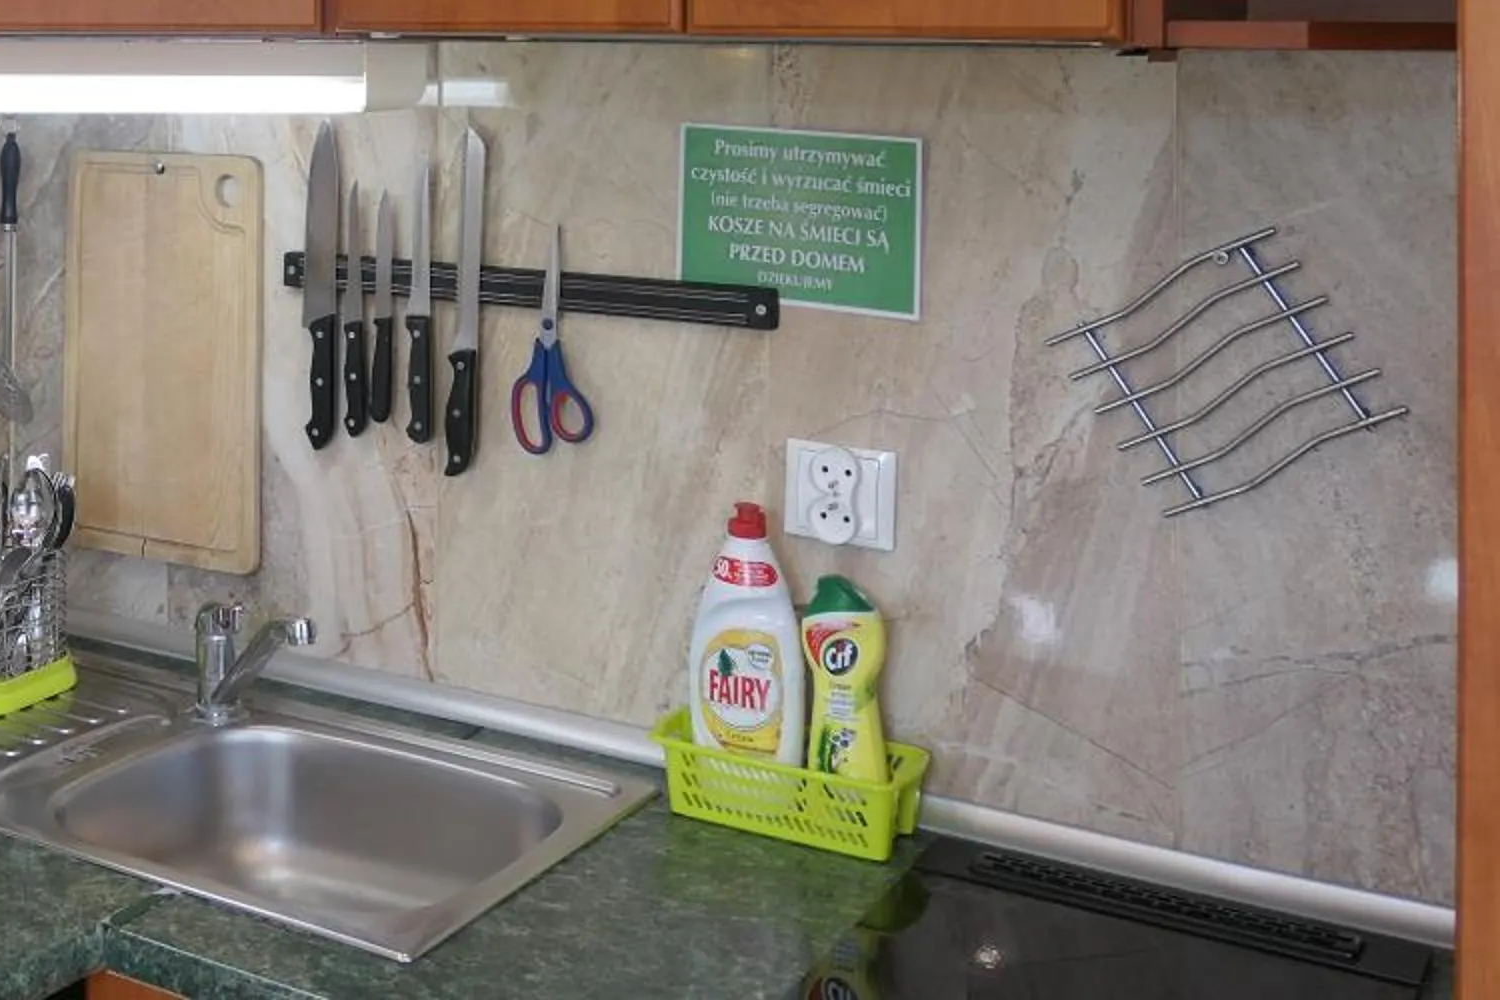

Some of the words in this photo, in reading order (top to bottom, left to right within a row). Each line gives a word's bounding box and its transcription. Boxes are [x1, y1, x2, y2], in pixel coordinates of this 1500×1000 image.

[714, 138, 778, 164] Prosimy
[783, 145, 886, 170] utrzymywać
[691, 166, 757, 188] czystość
[762, 166, 767, 185] i
[772, 173, 852, 194] wyrzucać
[857, 176, 911, 198] śmieci
[742, 193, 790, 213] trzeba
[707, 215, 764, 235] KOSZE
[769, 219, 795, 239] NA
[800, 219, 860, 245] ŚMIECI
[866, 228, 890, 255] SĄ
[729, 242, 786, 265] PRZED
[791, 248, 865, 274] DOMEM
[708, 668, 772, 712] FAIRY
